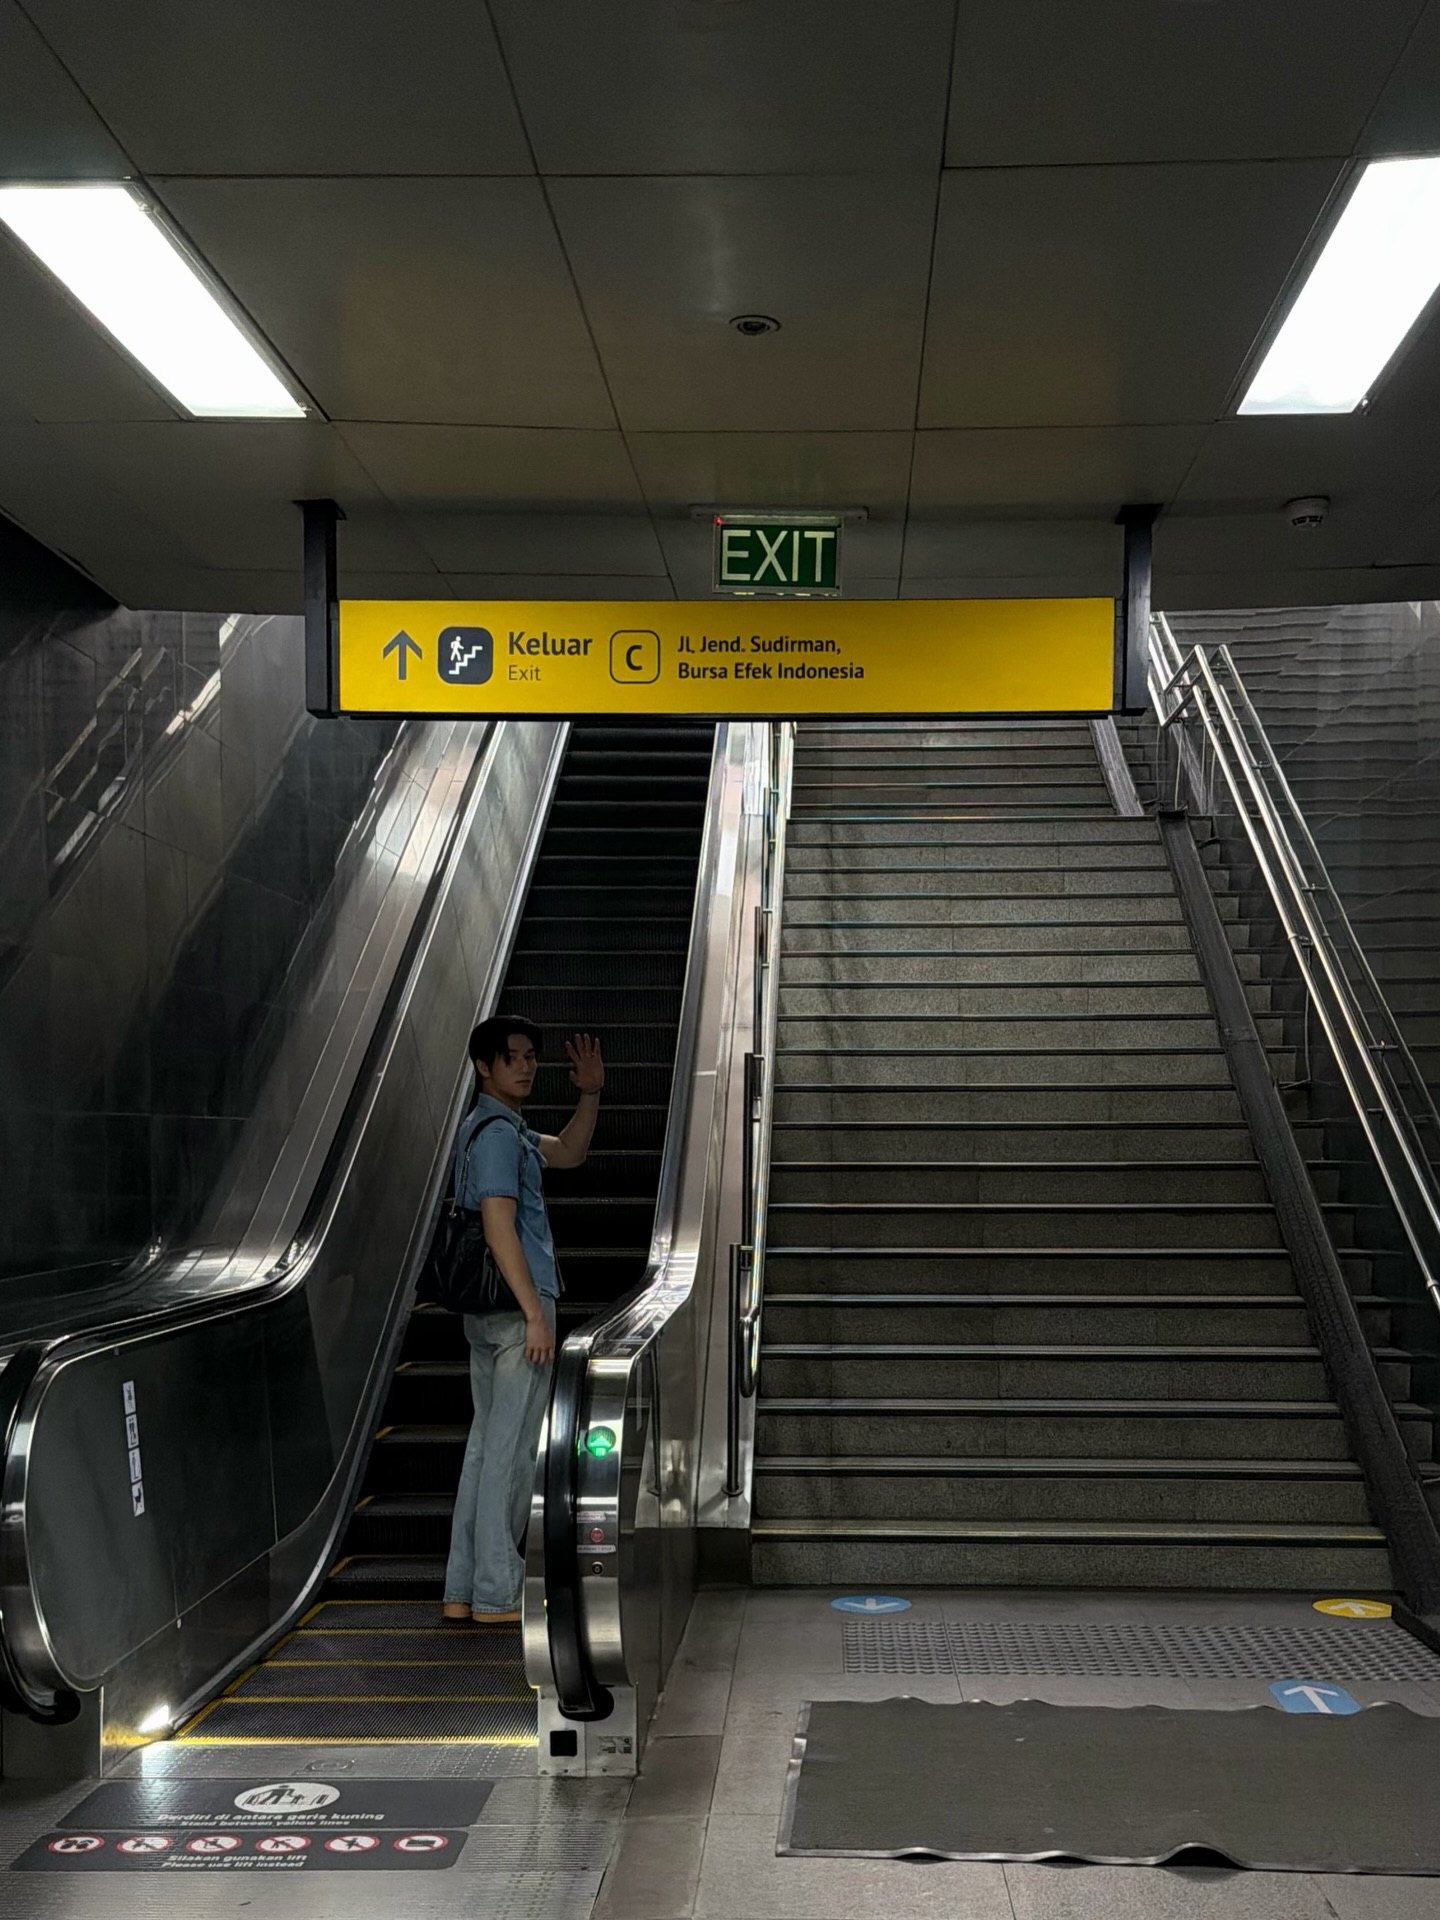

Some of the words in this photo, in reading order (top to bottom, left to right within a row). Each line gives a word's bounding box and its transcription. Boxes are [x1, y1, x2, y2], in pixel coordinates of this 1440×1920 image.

[722, 530, 835, 582] EXIT
[508, 631, 593, 656] Keluar
[677, 636, 695, 654] Jl.
[700, 636, 746, 653] Jend.
[750, 636, 842, 655] Sudirman,
[625, 644, 643, 671] C
[508, 665, 541, 681] Exit
[678, 662, 728, 680] Bursa
[734, 662, 773, 679] Efek
[778, 662, 865, 680] Indonesia
[286, 1813, 327, 1821] garis
[331, 1813, 385, 1821] kuning
